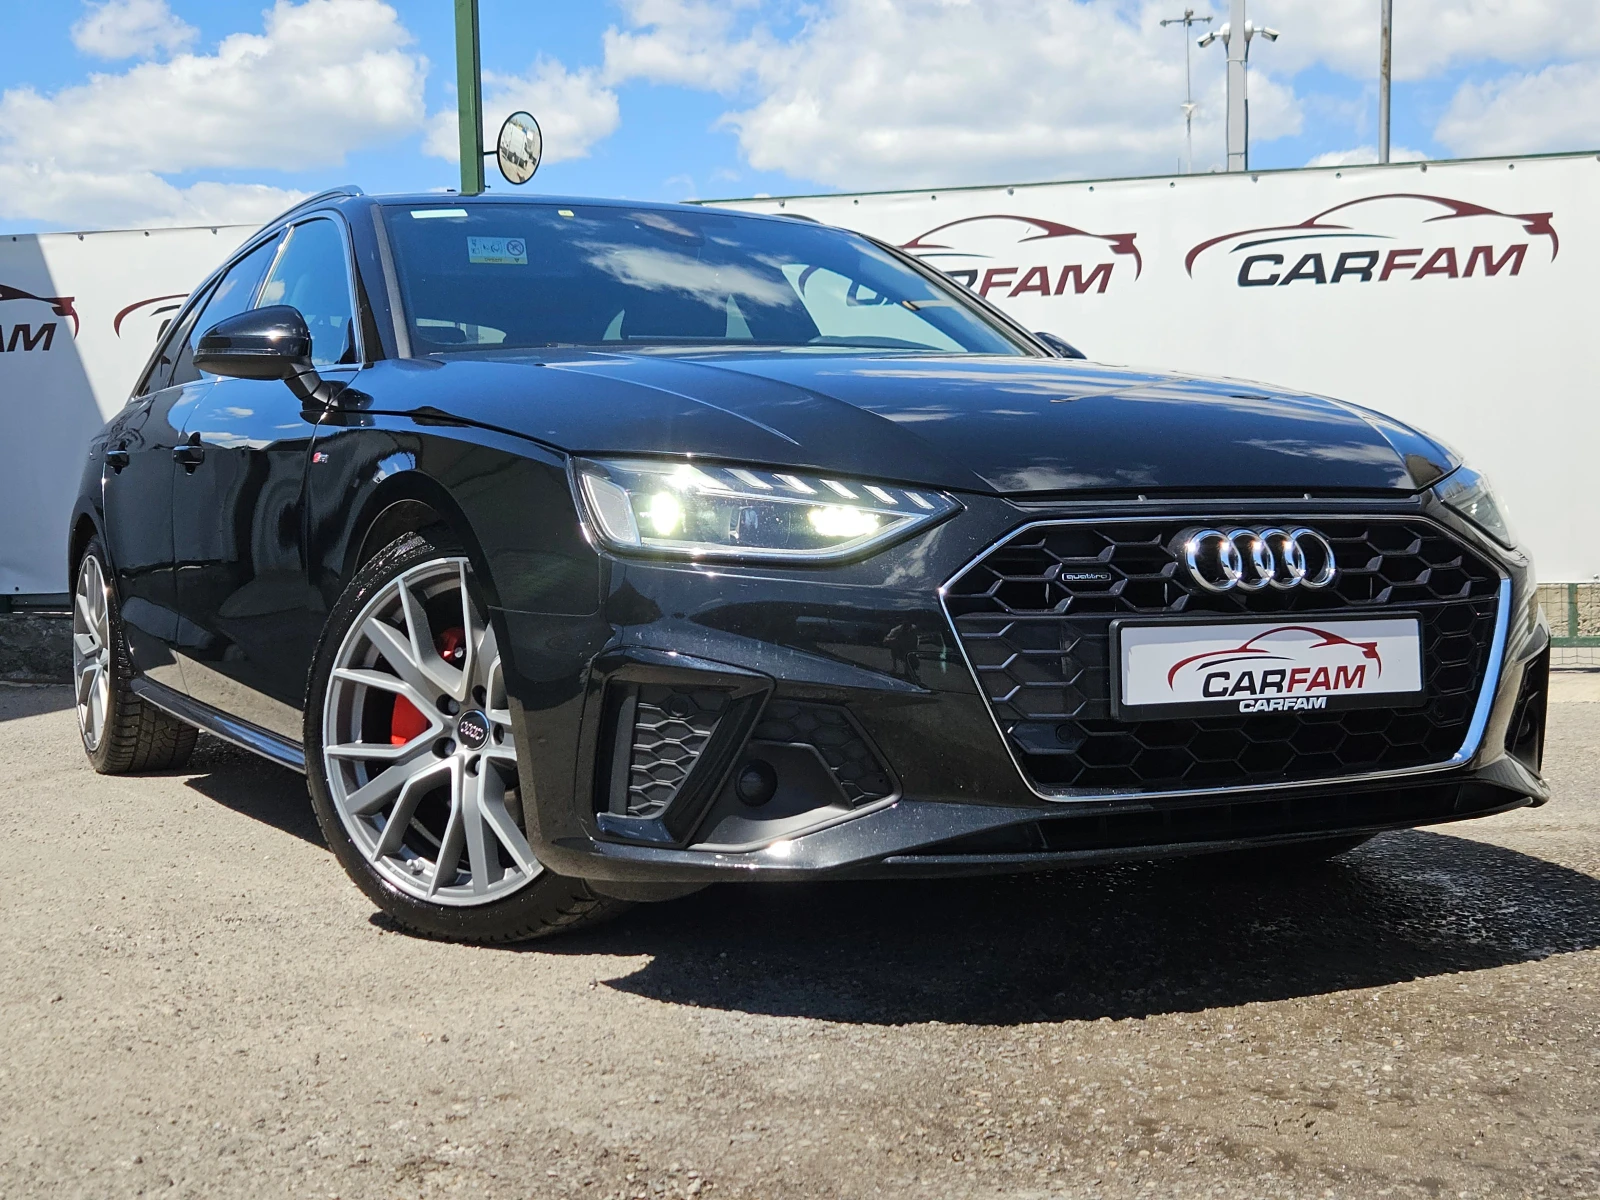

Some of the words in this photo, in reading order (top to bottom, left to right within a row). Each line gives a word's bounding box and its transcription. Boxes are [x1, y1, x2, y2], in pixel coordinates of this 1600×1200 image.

[1237, 244, 1529, 287] CARFAM
[1066, 573, 1108, 581] quattro
[1202, 664, 1367, 697] CARFAM
[1239, 697, 1327, 713] CARFAM
